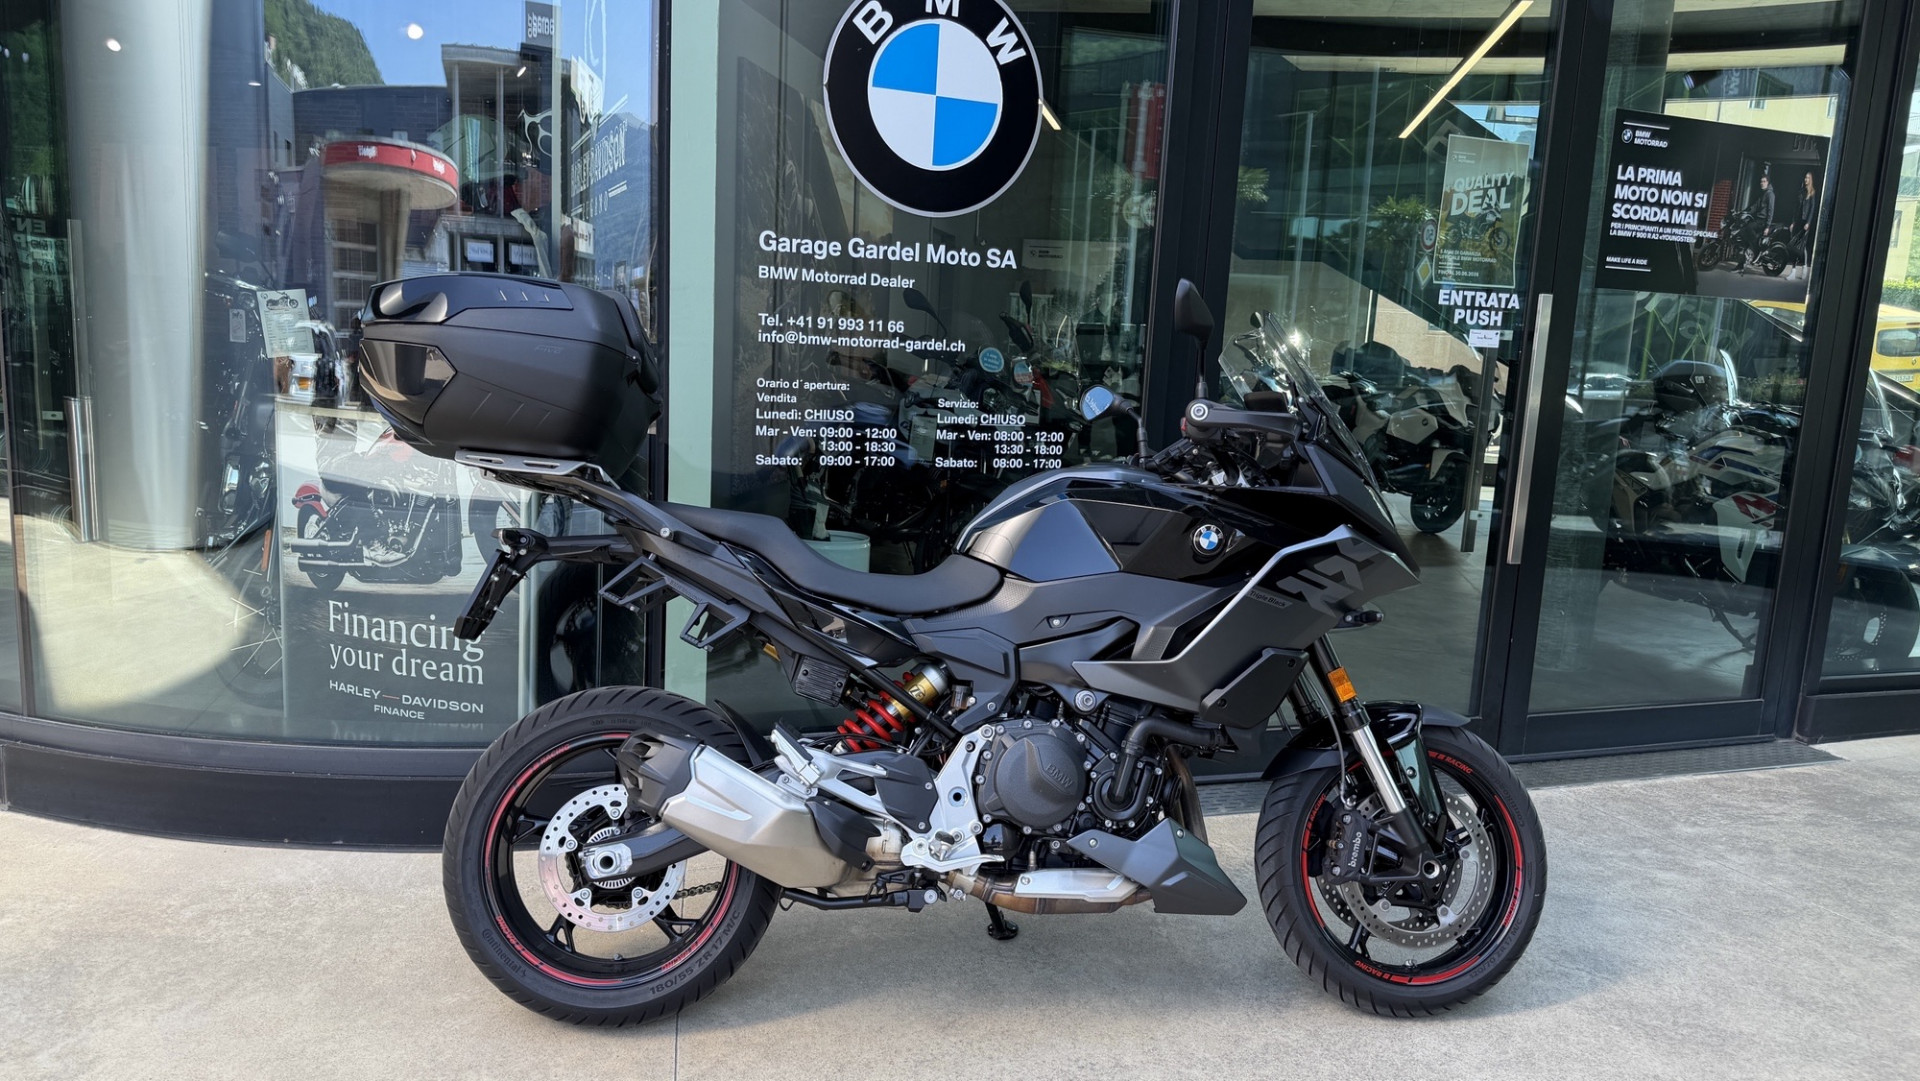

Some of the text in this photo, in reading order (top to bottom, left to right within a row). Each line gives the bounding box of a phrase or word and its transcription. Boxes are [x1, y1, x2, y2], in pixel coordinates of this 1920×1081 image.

[852, 0, 1026, 65] BMW
[1454, 171, 1514, 193] QUALITY
[1617, 165, 1682, 187] LA PRIMA
[1450, 186, 1511, 216] DEAL
[1614, 184, 1708, 208] MOTO NON SI
[1612, 203, 1699, 226] SCORDA MAI
[1672, 228, 1692, 236] PREZZO
[759, 230, 1018, 269] Garage Gardel Moto SA
[758, 265, 915, 289] BMW Motorrad Dealer
[1438, 289, 1520, 310] ENTRATA
[758, 313, 905, 333] Tel. +41 91 993 11 66
[1453, 308, 1503, 327] PUSH
[758, 331, 966, 352] info@bmw-motorrad-gardel.ch
[756, 377, 790, 389] Orario
[756, 392, 797, 403] Vendita
[938, 399, 979, 409] Servizio:
[755, 408, 855, 422] Lunedì: CHIUSO
[980, 414, 1026, 426] CHIUSO
[755, 425, 780, 437] Mar
[790, 426, 817, 438] Ven:
[819, 427, 853, 439] 09:00
[865, 428, 898, 440] 12:00
[936, 429, 958, 440] Mar
[967, 430, 991, 441] Ven:
[993, 431, 1025, 442] 08:00
[1034, 432, 1064, 443] 12:00
[820, 441, 853, 452] 13:00
[864, 442, 896, 453] 18:30
[994, 444, 1024, 455] 13:30
[1034, 445, 1063, 455] 18:00
[755, 455, 803, 466] Sabato:
[819, 455, 853, 467] 09:00
[863, 456, 895, 467] 17:00
[935, 457, 978, 468] Sabato:
[993, 458, 1023, 469] 08:00
[1033, 459, 1062, 469] 17:00
[328, 600, 486, 662] Financing
[330, 643, 484, 685] your dream
[329, 680, 484, 714] HARLEY DAVIDSON
[373, 704, 425, 720] FINANCE
[1046, 763, 1073, 788] BMW
[1446, 756, 1473, 775] RACING
[1348, 831, 1362, 867] brembo
[482, 928, 521, 975] Continental
[649, 910, 741, 995] 180/55 ZR 17 M/C
